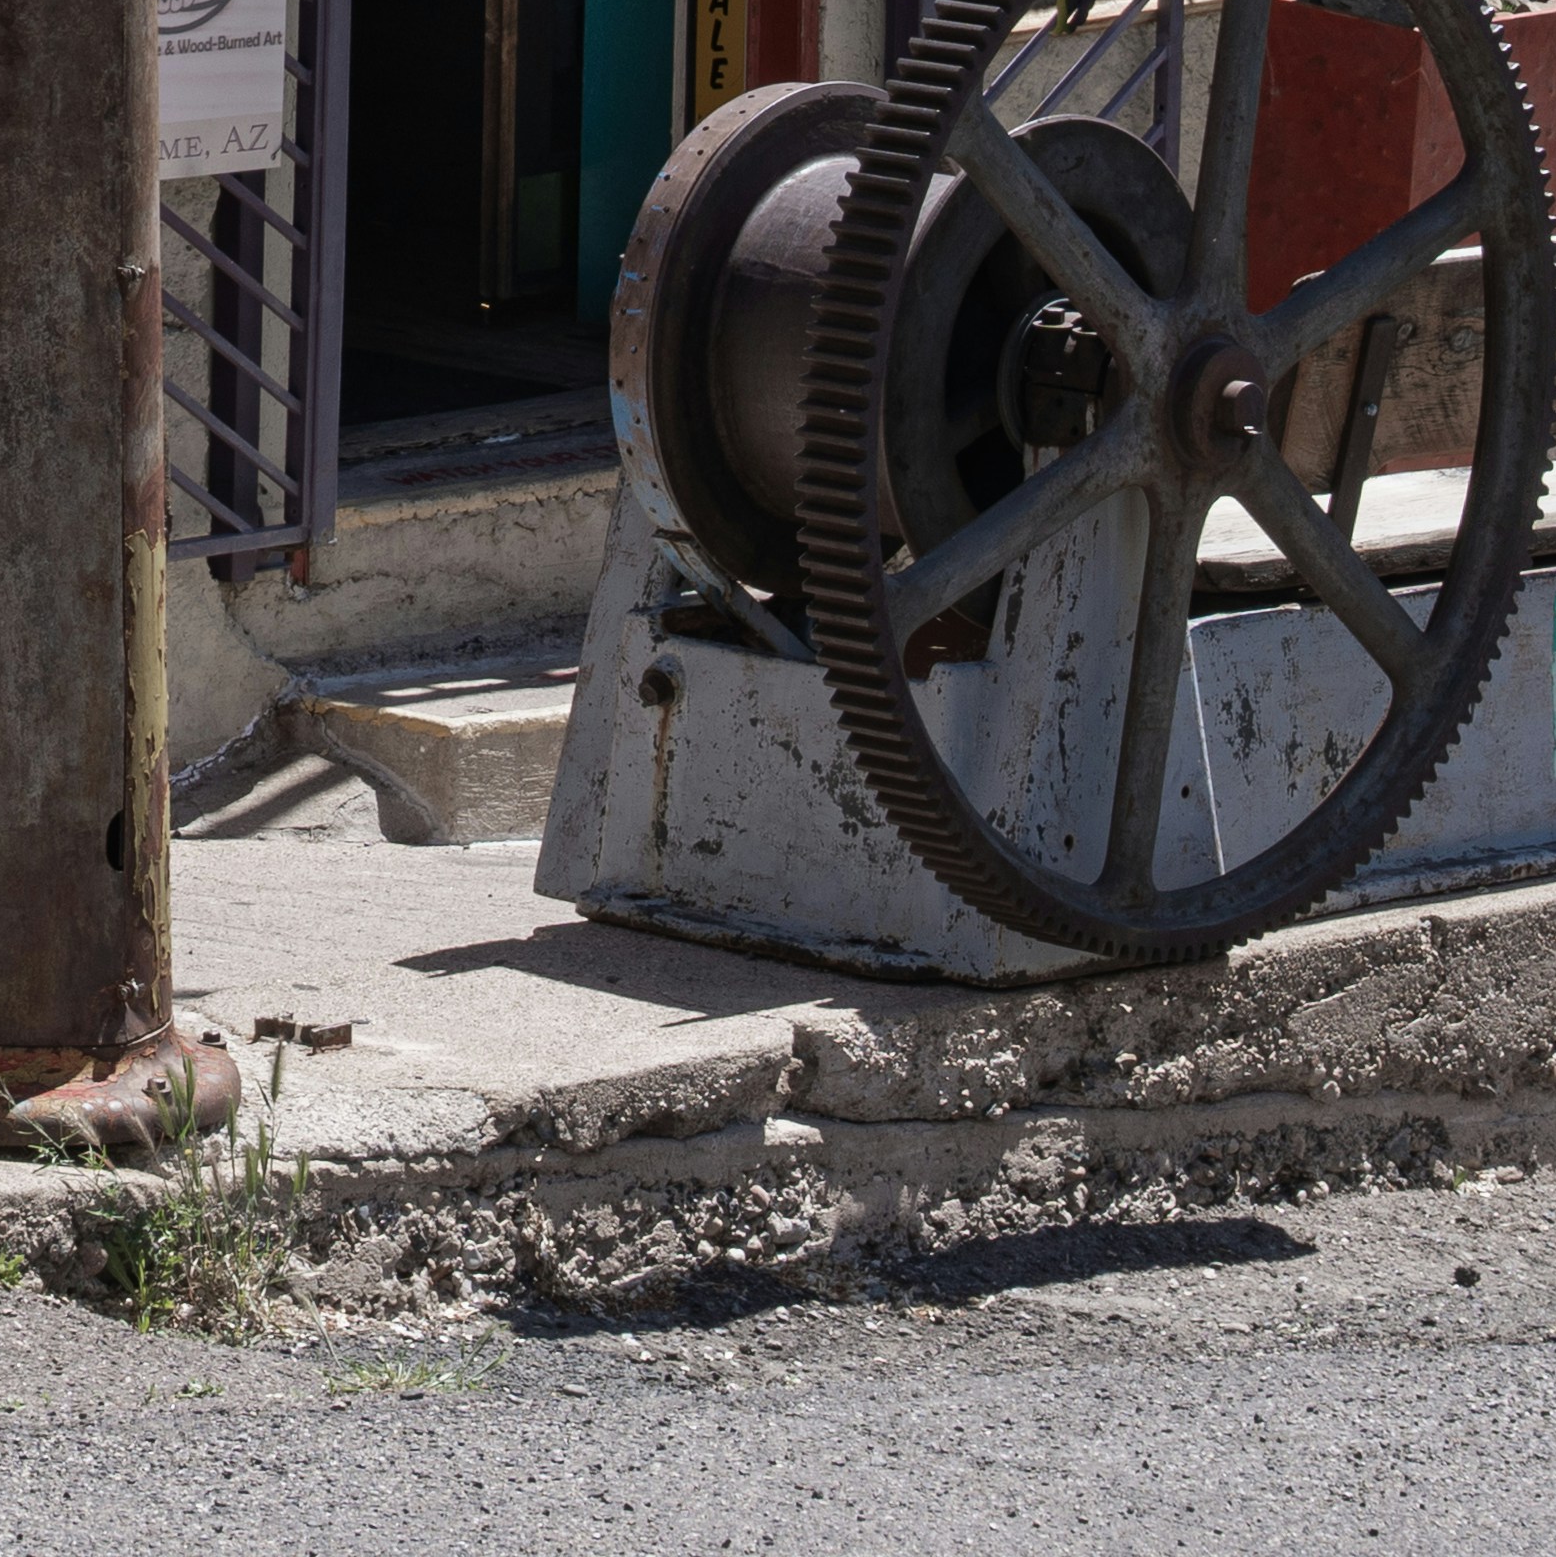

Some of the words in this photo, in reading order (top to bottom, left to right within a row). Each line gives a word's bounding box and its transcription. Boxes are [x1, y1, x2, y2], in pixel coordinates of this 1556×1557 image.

[178, 32, 261, 54] Wood-Burned
[263, 30, 283, 46] Art
[220, 123, 269, 154] AZ
[384, 462, 501, 486] WATCH
[496, 451, 588, 470] YOUR
